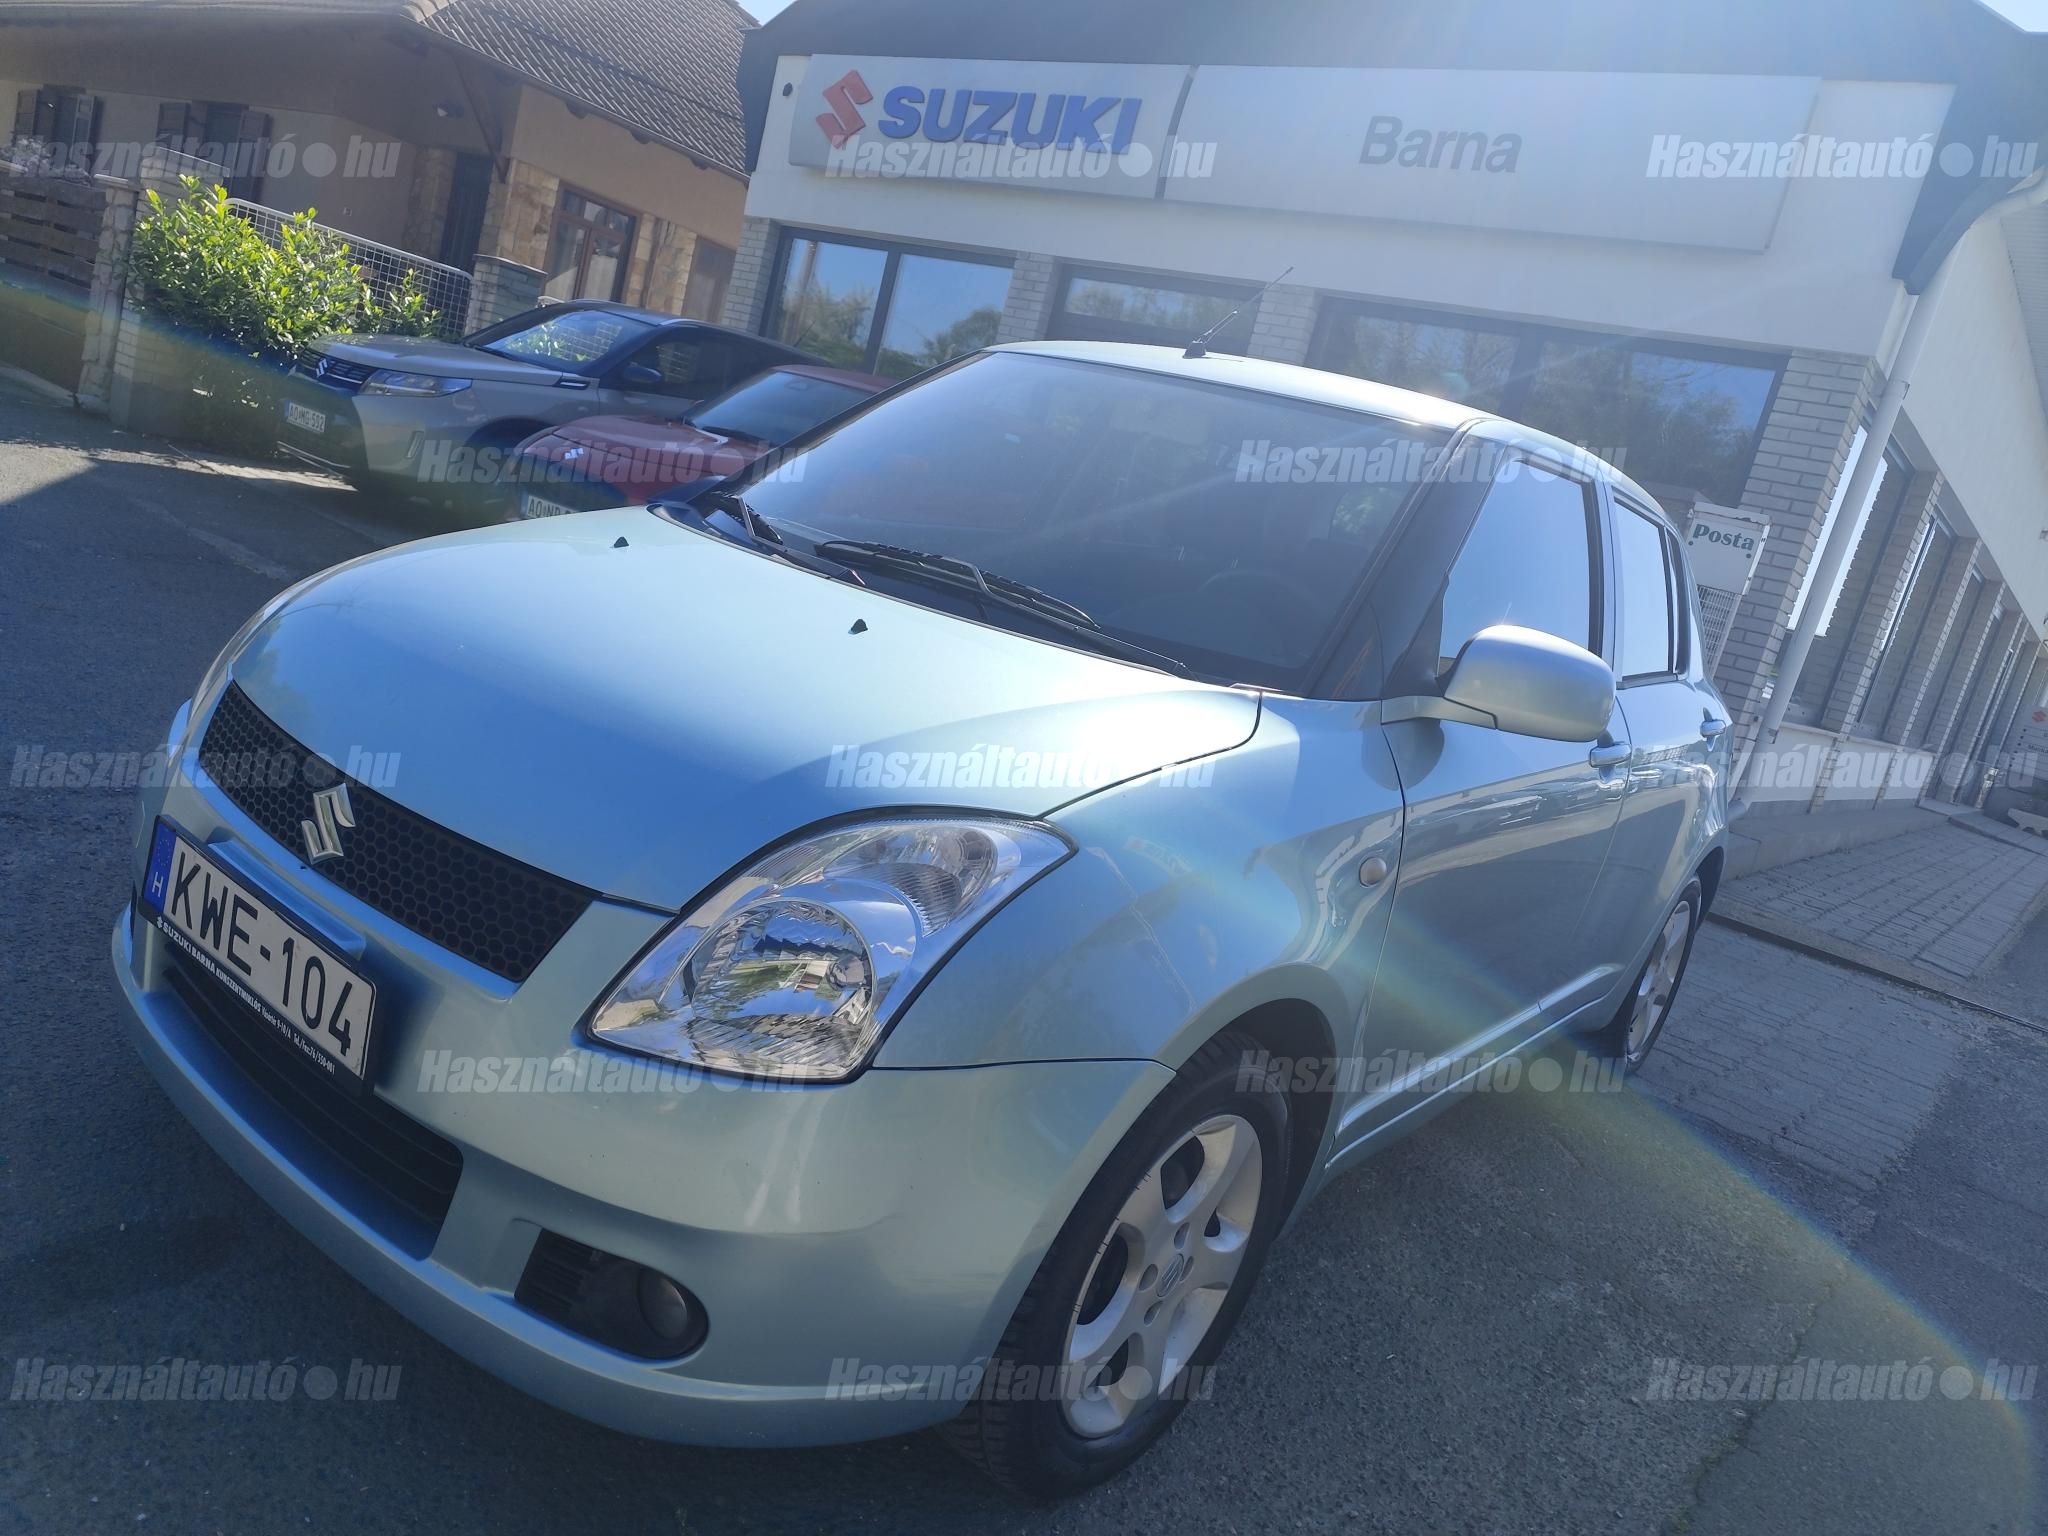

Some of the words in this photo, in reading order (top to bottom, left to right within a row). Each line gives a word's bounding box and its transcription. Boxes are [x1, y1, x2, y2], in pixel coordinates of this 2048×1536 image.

[878, 86, 1141, 155] SUZUKI
[1359, 115, 1522, 173] Barna
[1693, 524, 1754, 550] Posta
[151, 871, 163, 898] H
[163, 921, 192, 953] SUZUKI
[191, 946, 215, 974] BARNA
[171, 851, 353, 1056] KWE-104
